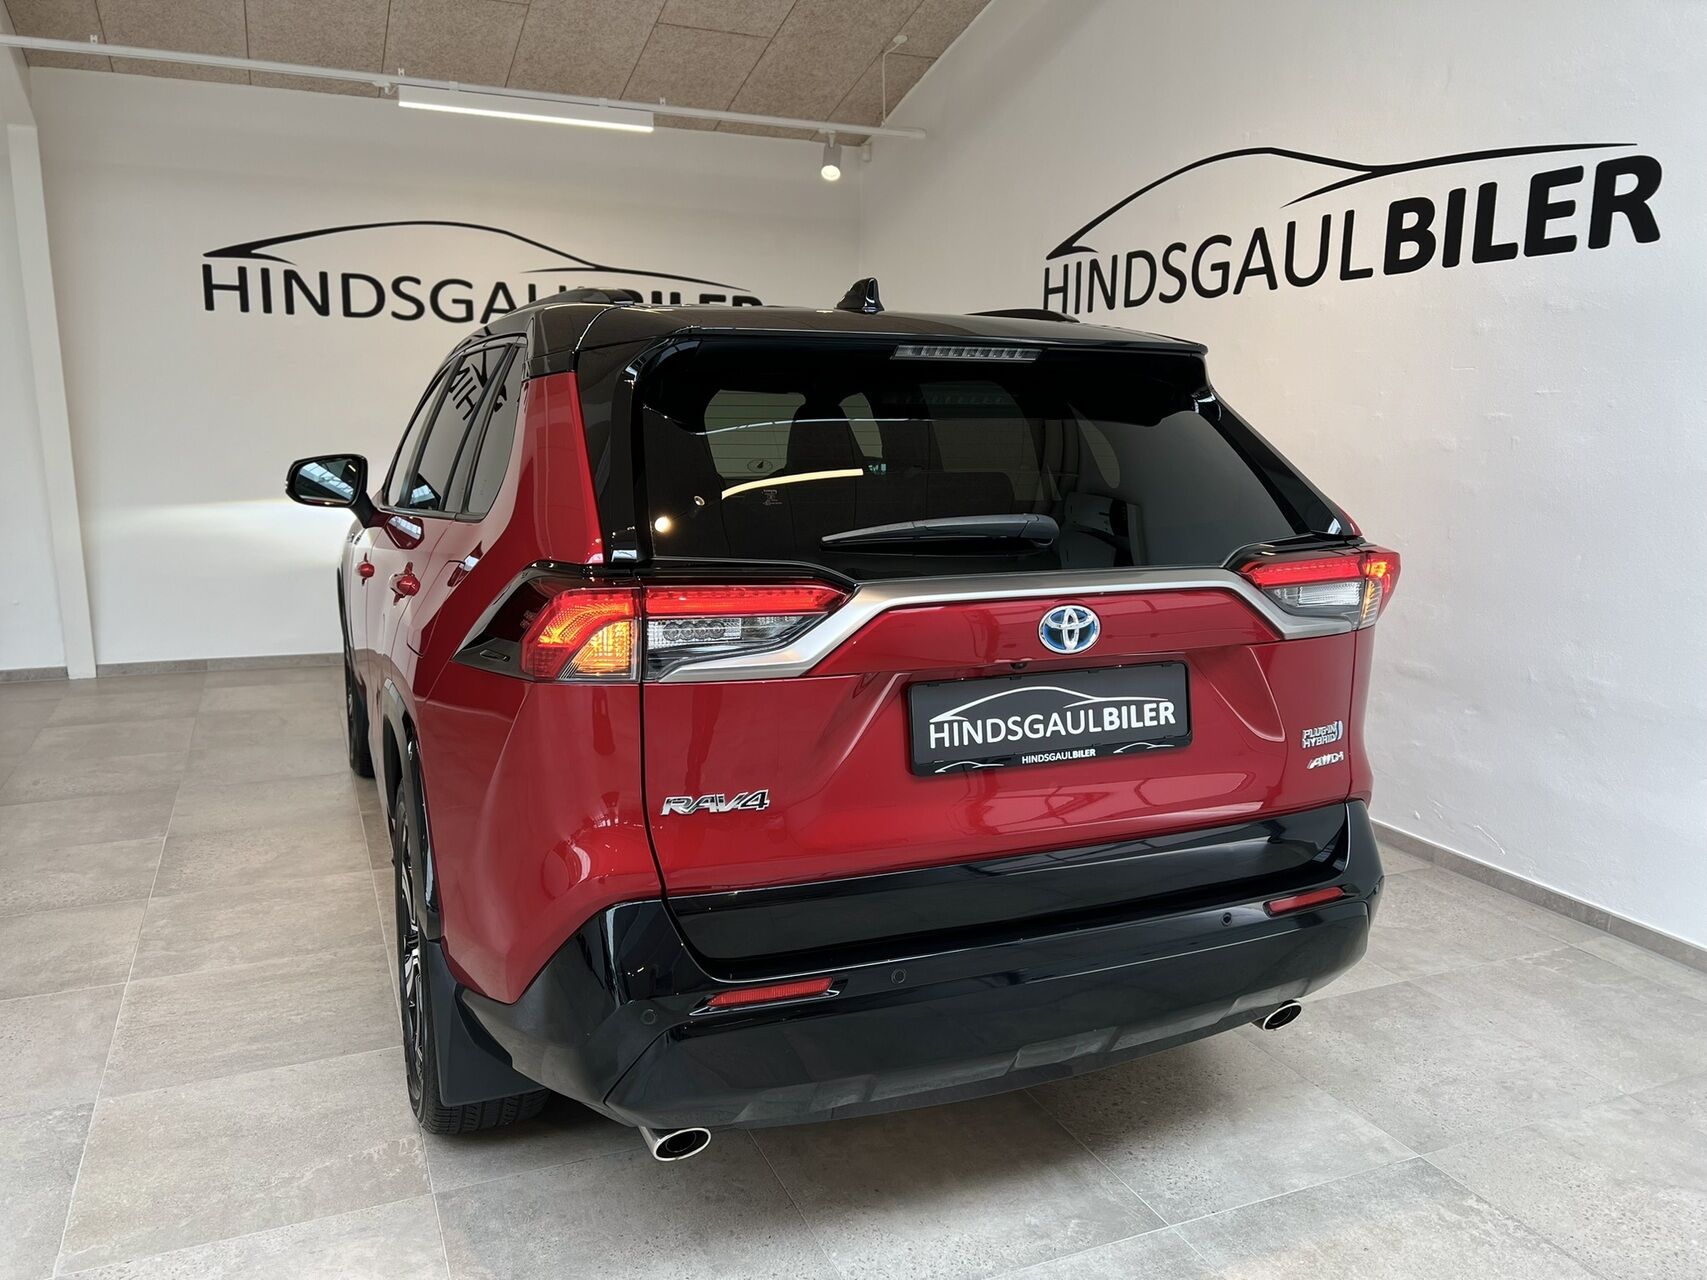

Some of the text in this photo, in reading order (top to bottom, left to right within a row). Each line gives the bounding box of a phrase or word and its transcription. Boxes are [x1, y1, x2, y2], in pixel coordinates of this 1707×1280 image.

[1043, 155, 1662, 314] HINDSGAULBILER
[929, 701, 1176, 749] HINDSGAULBILER
[1302, 733, 1338, 748] HYBRID
[1021, 748, 1096, 765] HINDSGAULBILER
[660, 789, 771, 816] RAV4
